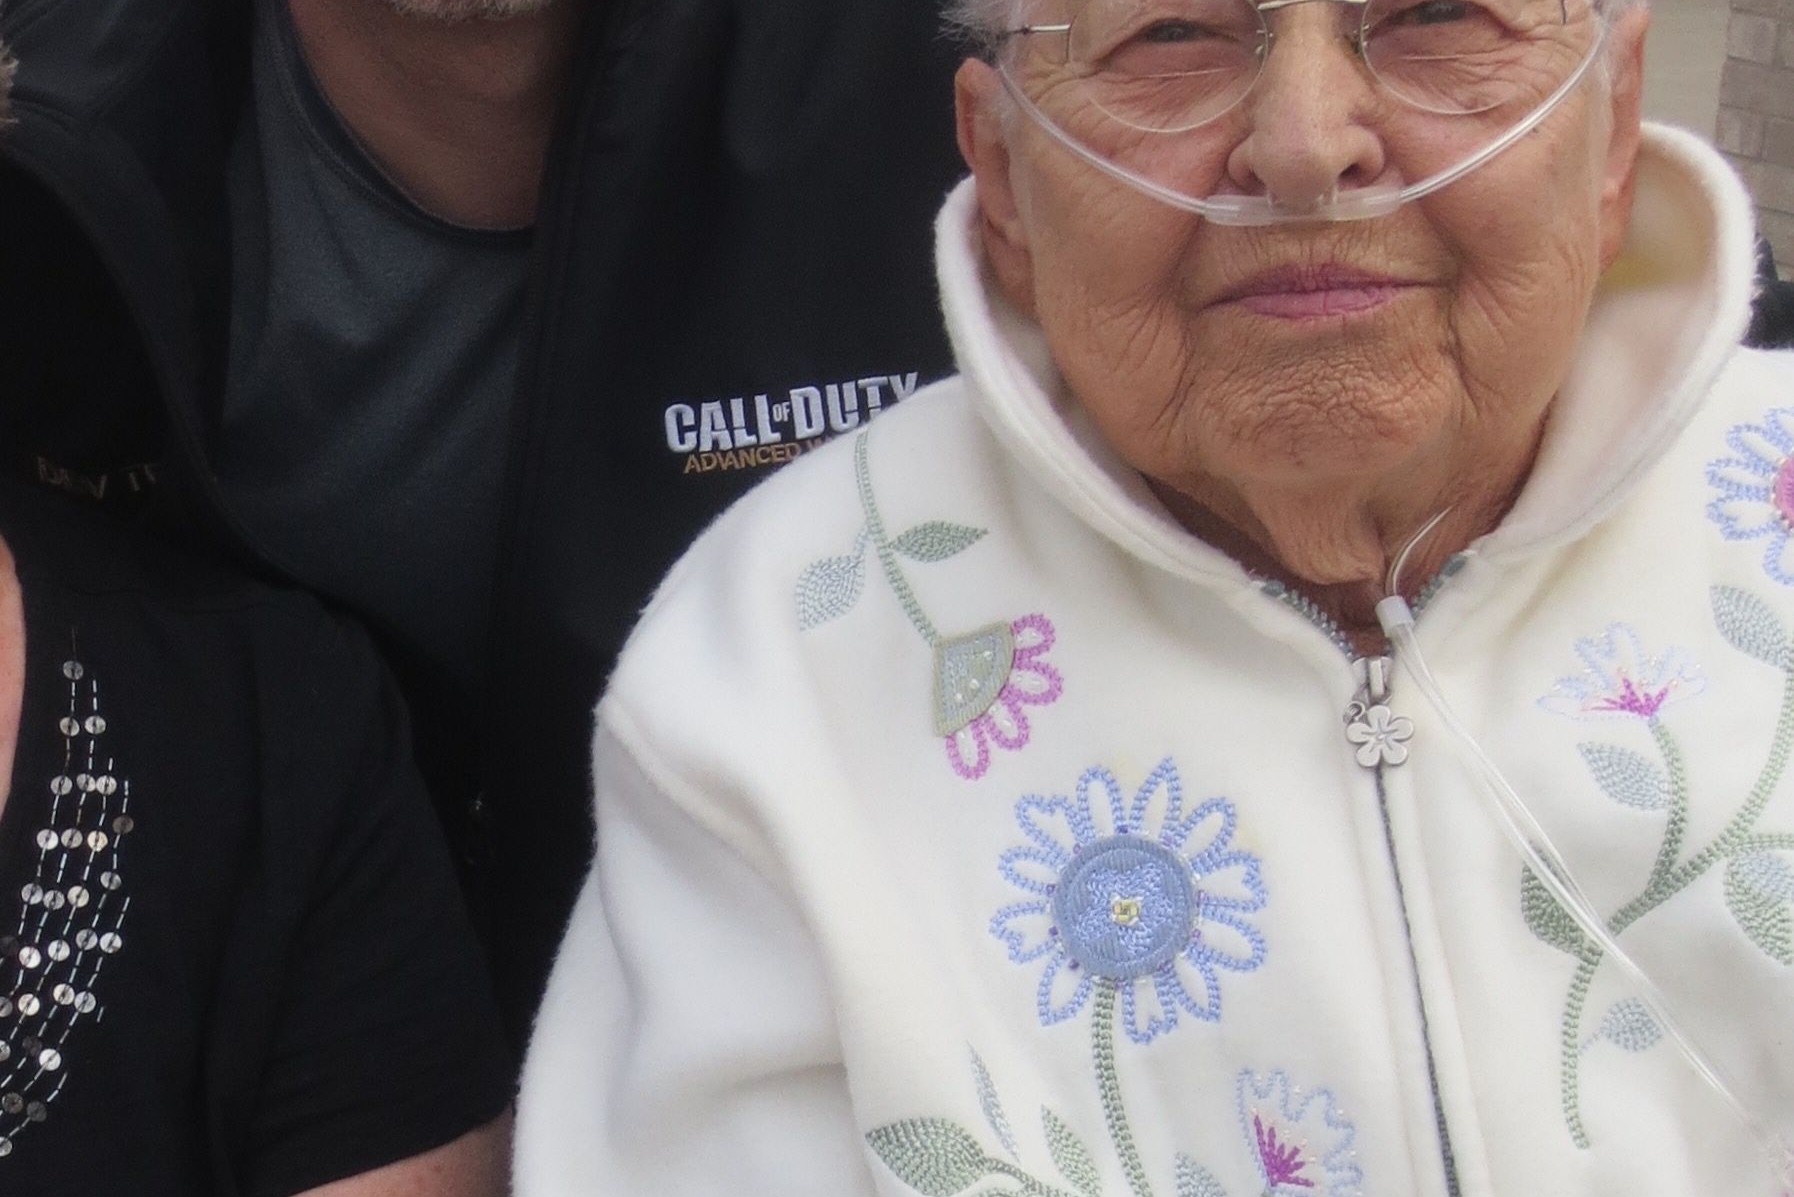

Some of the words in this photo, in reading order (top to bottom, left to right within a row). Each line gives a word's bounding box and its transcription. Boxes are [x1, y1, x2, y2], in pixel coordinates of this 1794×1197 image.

[664, 394, 782, 453] CALL
[773, 401, 790, 422] OF
[683, 442, 801, 474] ADVANCED
